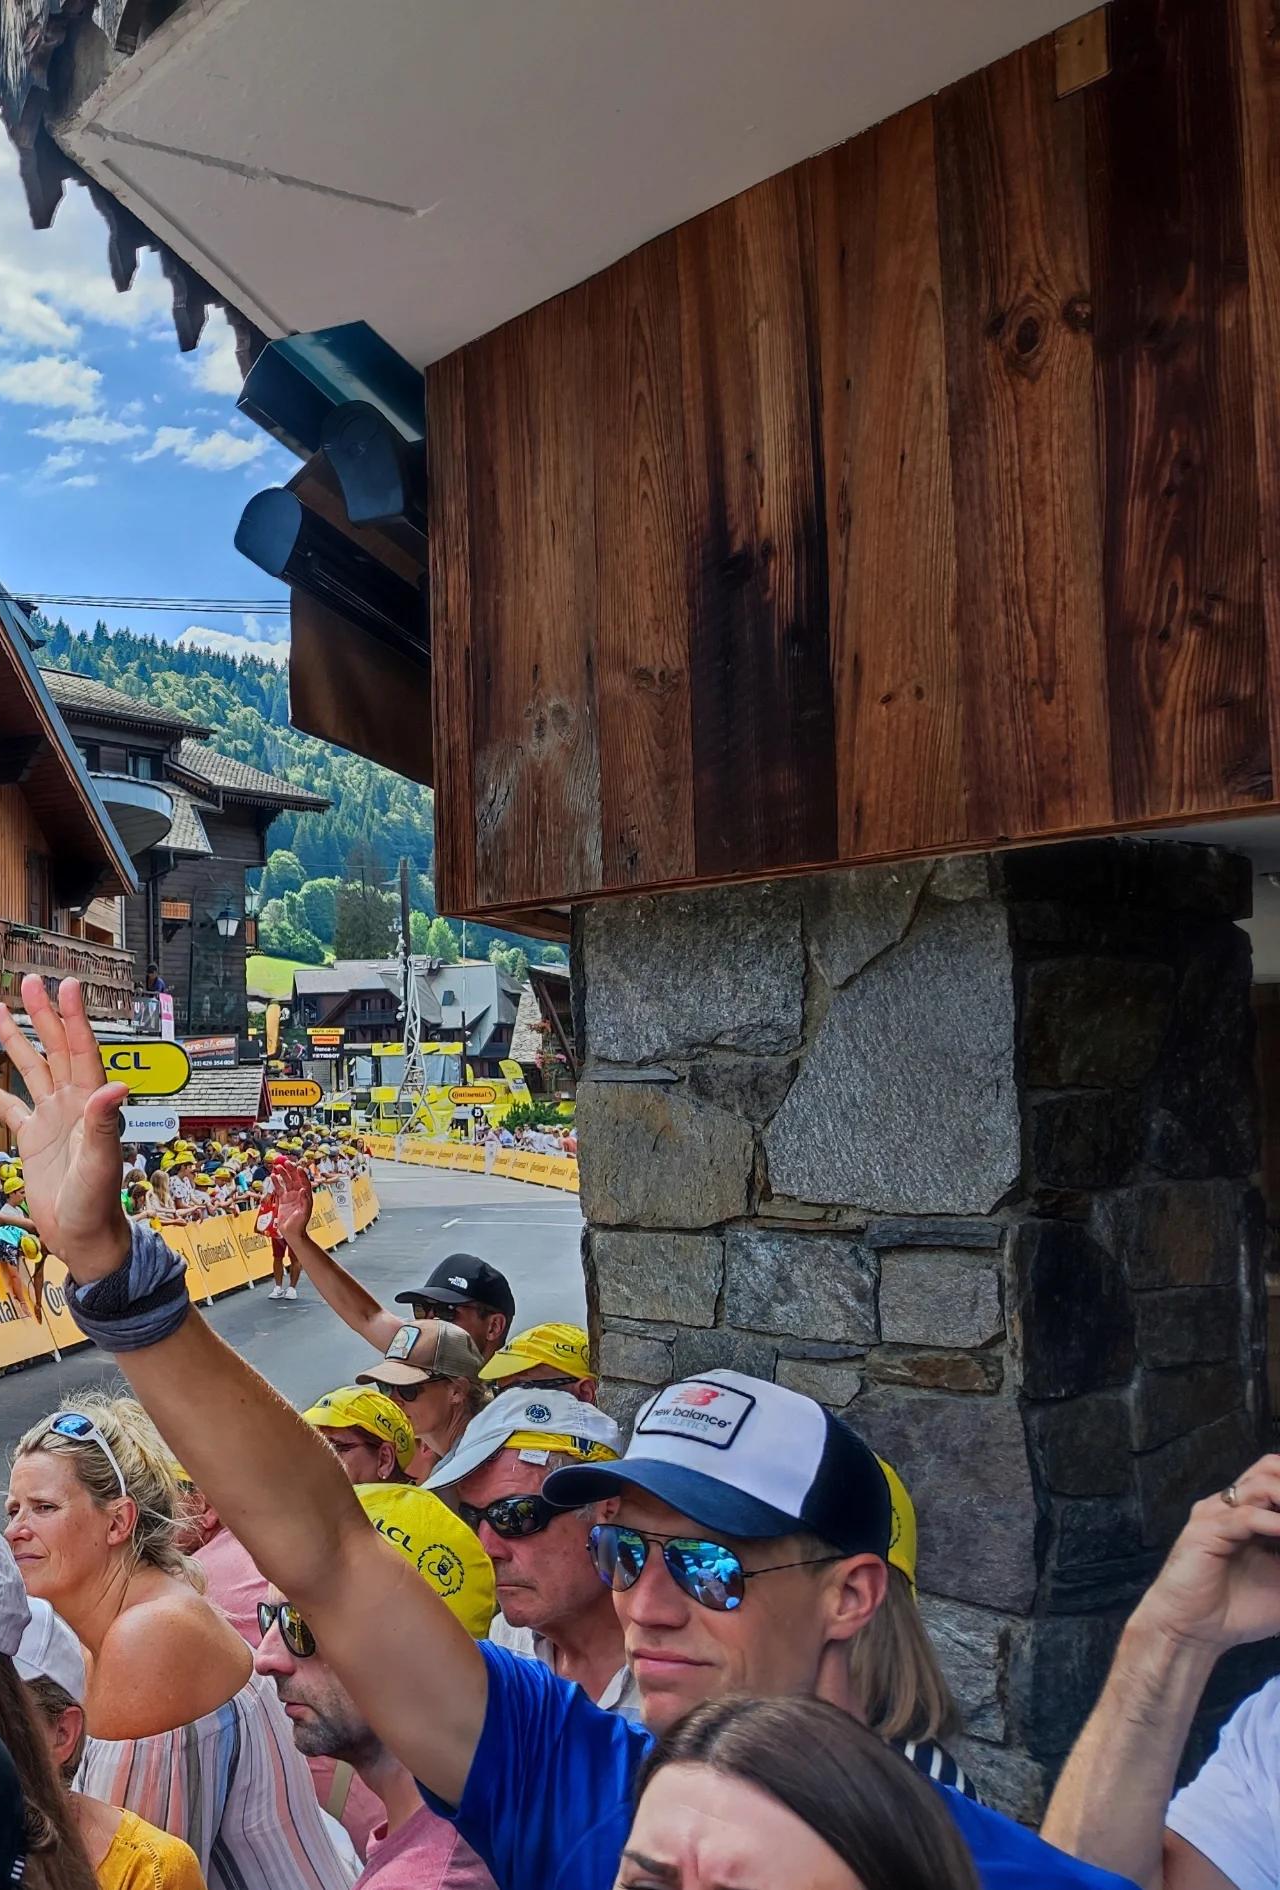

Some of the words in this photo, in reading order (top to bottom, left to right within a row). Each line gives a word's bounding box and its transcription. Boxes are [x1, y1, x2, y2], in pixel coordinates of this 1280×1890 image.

[269, 1087, 308, 1097] tinental
[128, 1119, 164, 1128] E.Leclerc
[289, 1114, 300, 1126] 50
[555, 1342, 578, 1355] LCL
[651, 1407, 672, 1417] new
[377, 1413, 394, 1432] LCL
[374, 1517, 414, 1553] LCL
